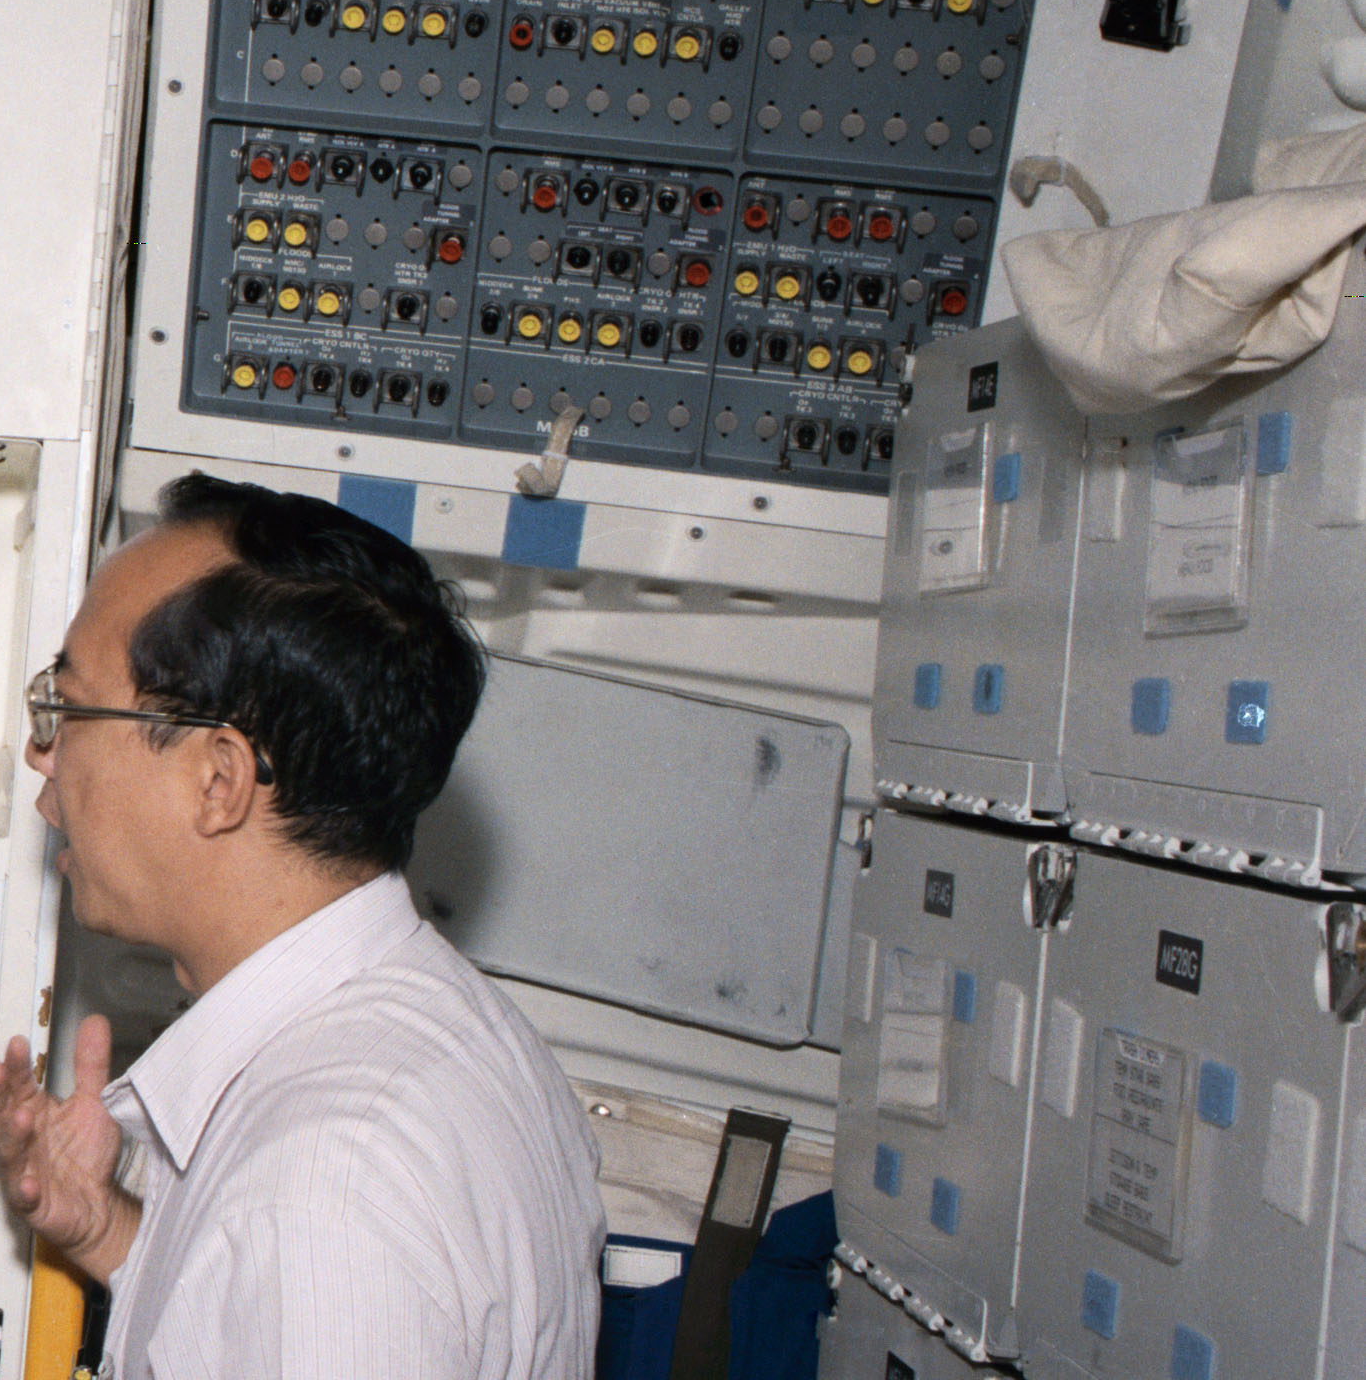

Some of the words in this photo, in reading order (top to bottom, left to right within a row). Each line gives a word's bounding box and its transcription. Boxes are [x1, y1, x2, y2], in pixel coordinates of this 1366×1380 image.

[719, 4, 750, 13] GALLEY
[237, 51, 244, 59] C
[749, 180, 765, 188] ANT
[293, 201, 318, 210] WASTE
[324, 329, 343, 338] ESS
[807, 381, 826, 390] ESS
[1161, 943, 1199, 981] MF28G
